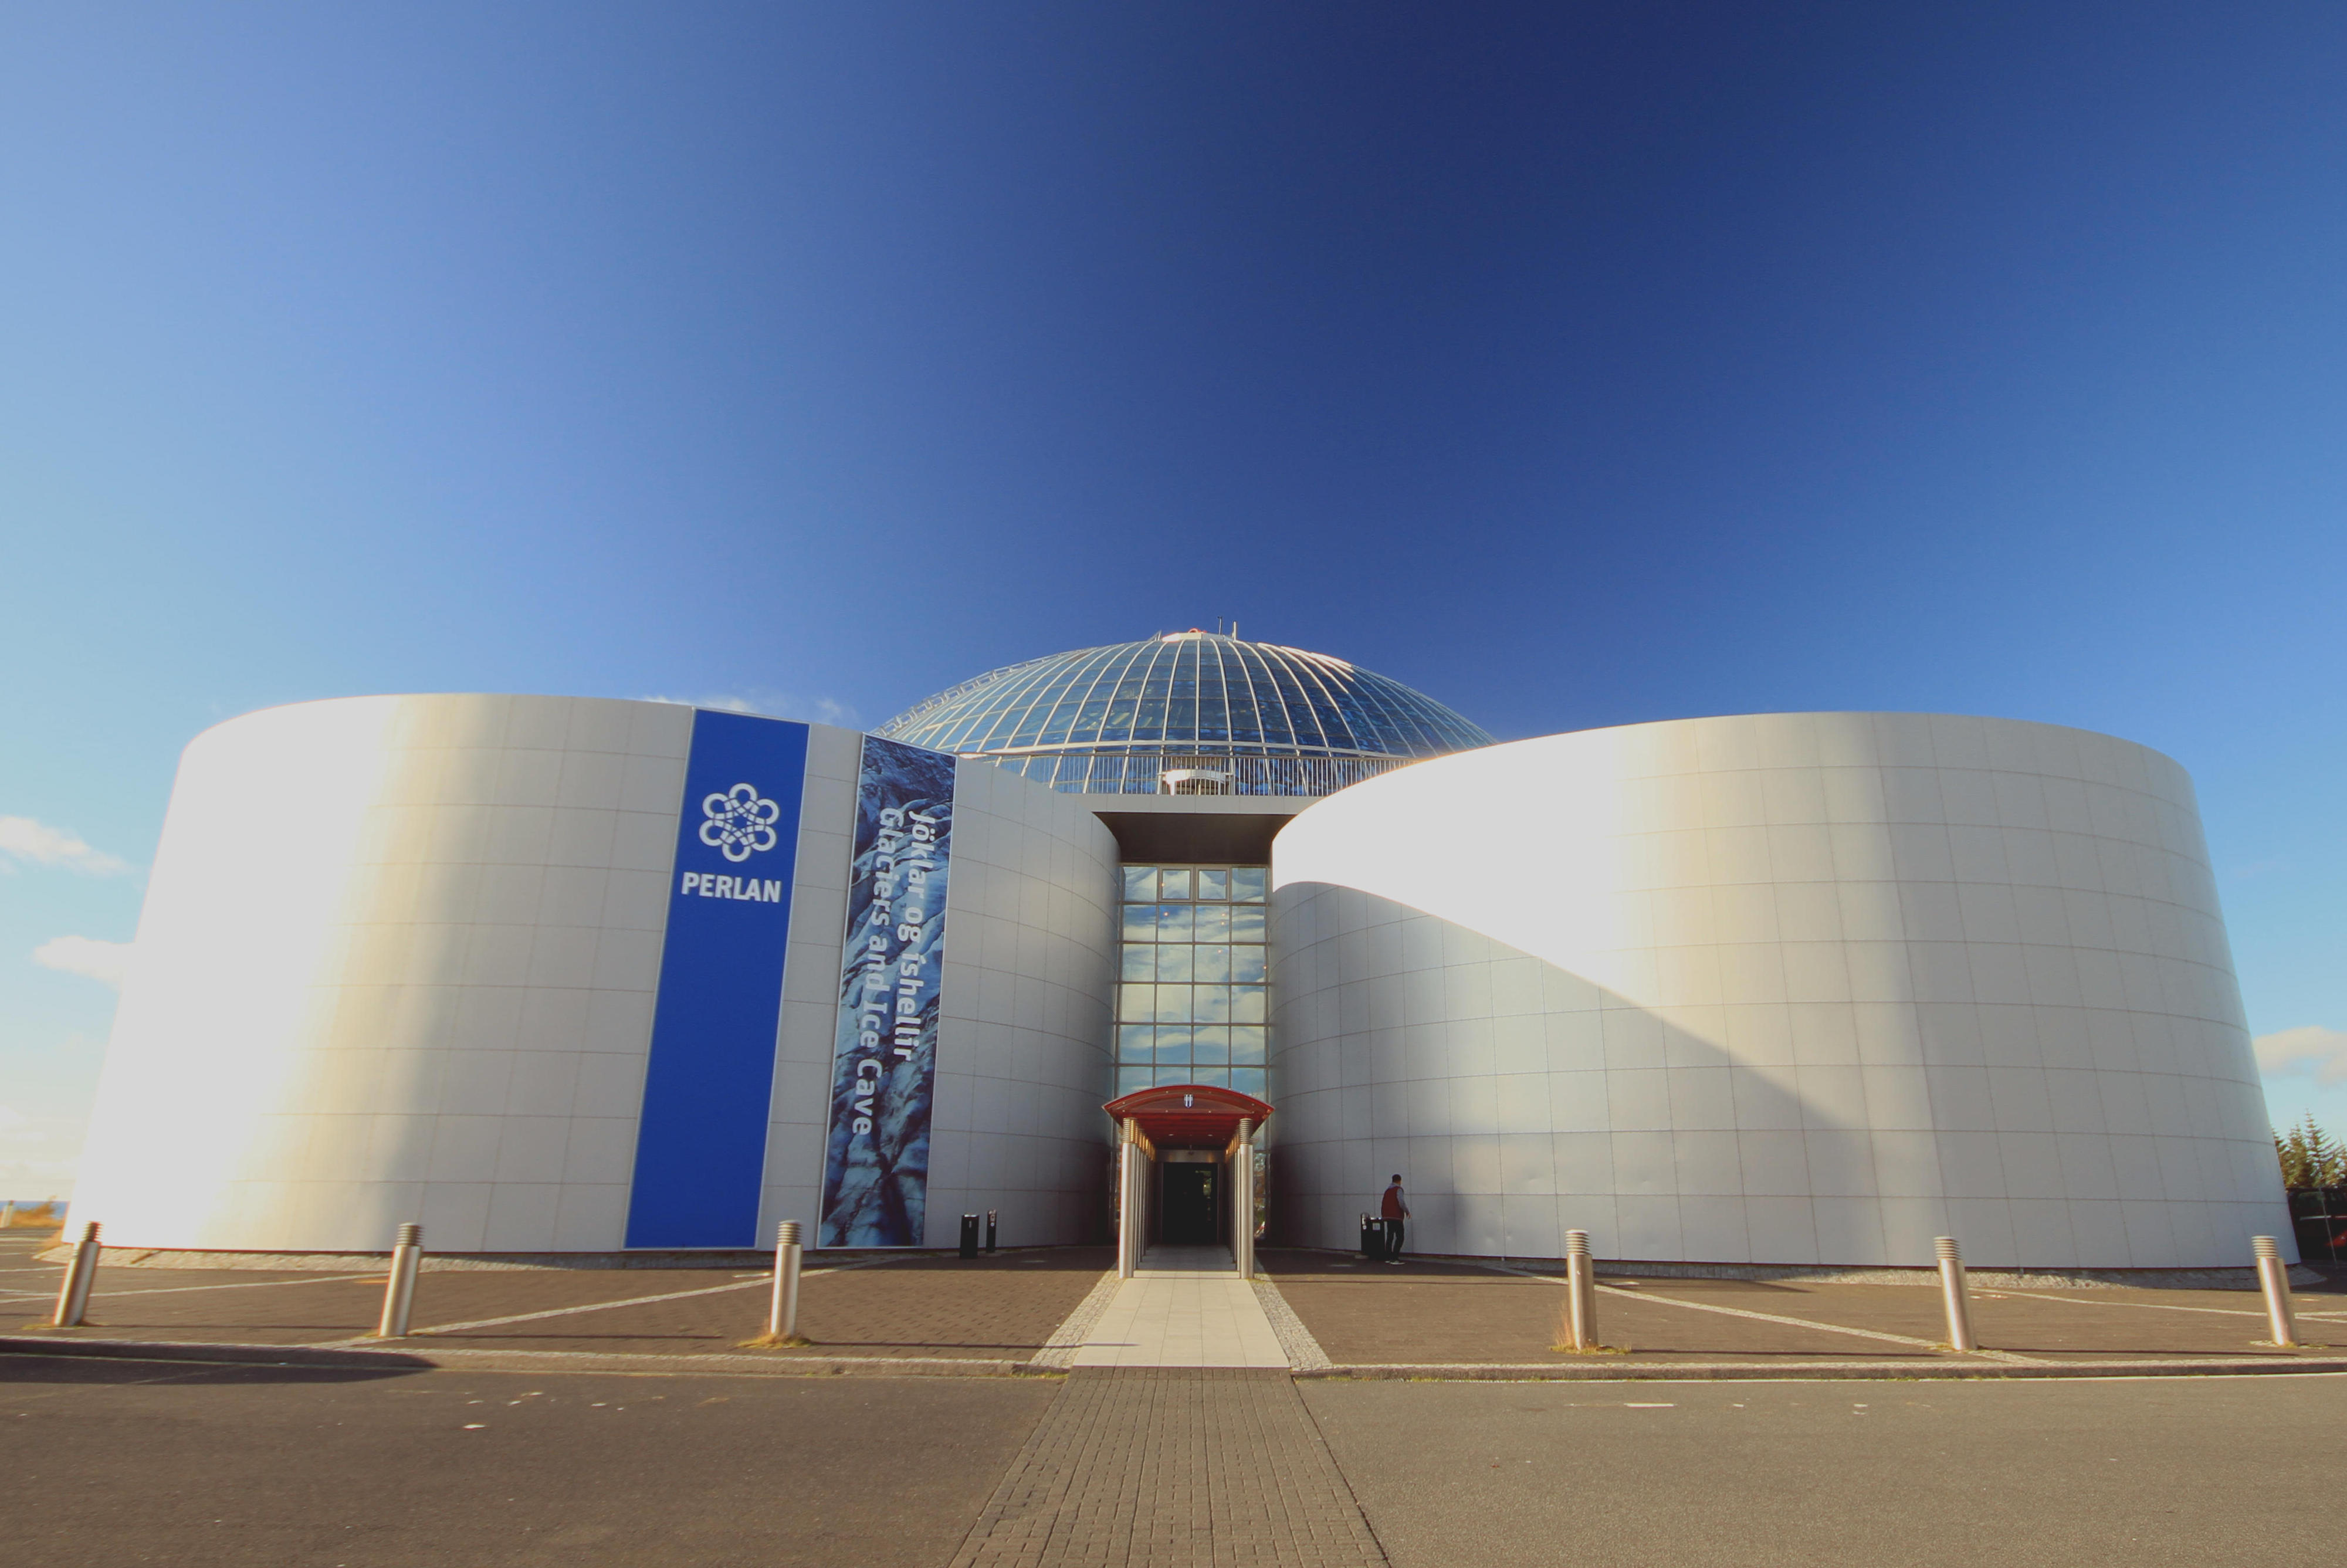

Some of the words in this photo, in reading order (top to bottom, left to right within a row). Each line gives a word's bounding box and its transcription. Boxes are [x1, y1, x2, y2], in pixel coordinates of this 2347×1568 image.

[681, 872, 781, 903] PERLAN
[871, 808, 904, 926] Glaciers
[909, 811, 936, 899] Jöklar
[898, 907, 923, 943] og
[865, 935, 890, 991] and
[860, 1000, 888, 1048] Ice
[893, 953, 926, 1061] íshellir
[852, 1059, 882, 1135] Cave
